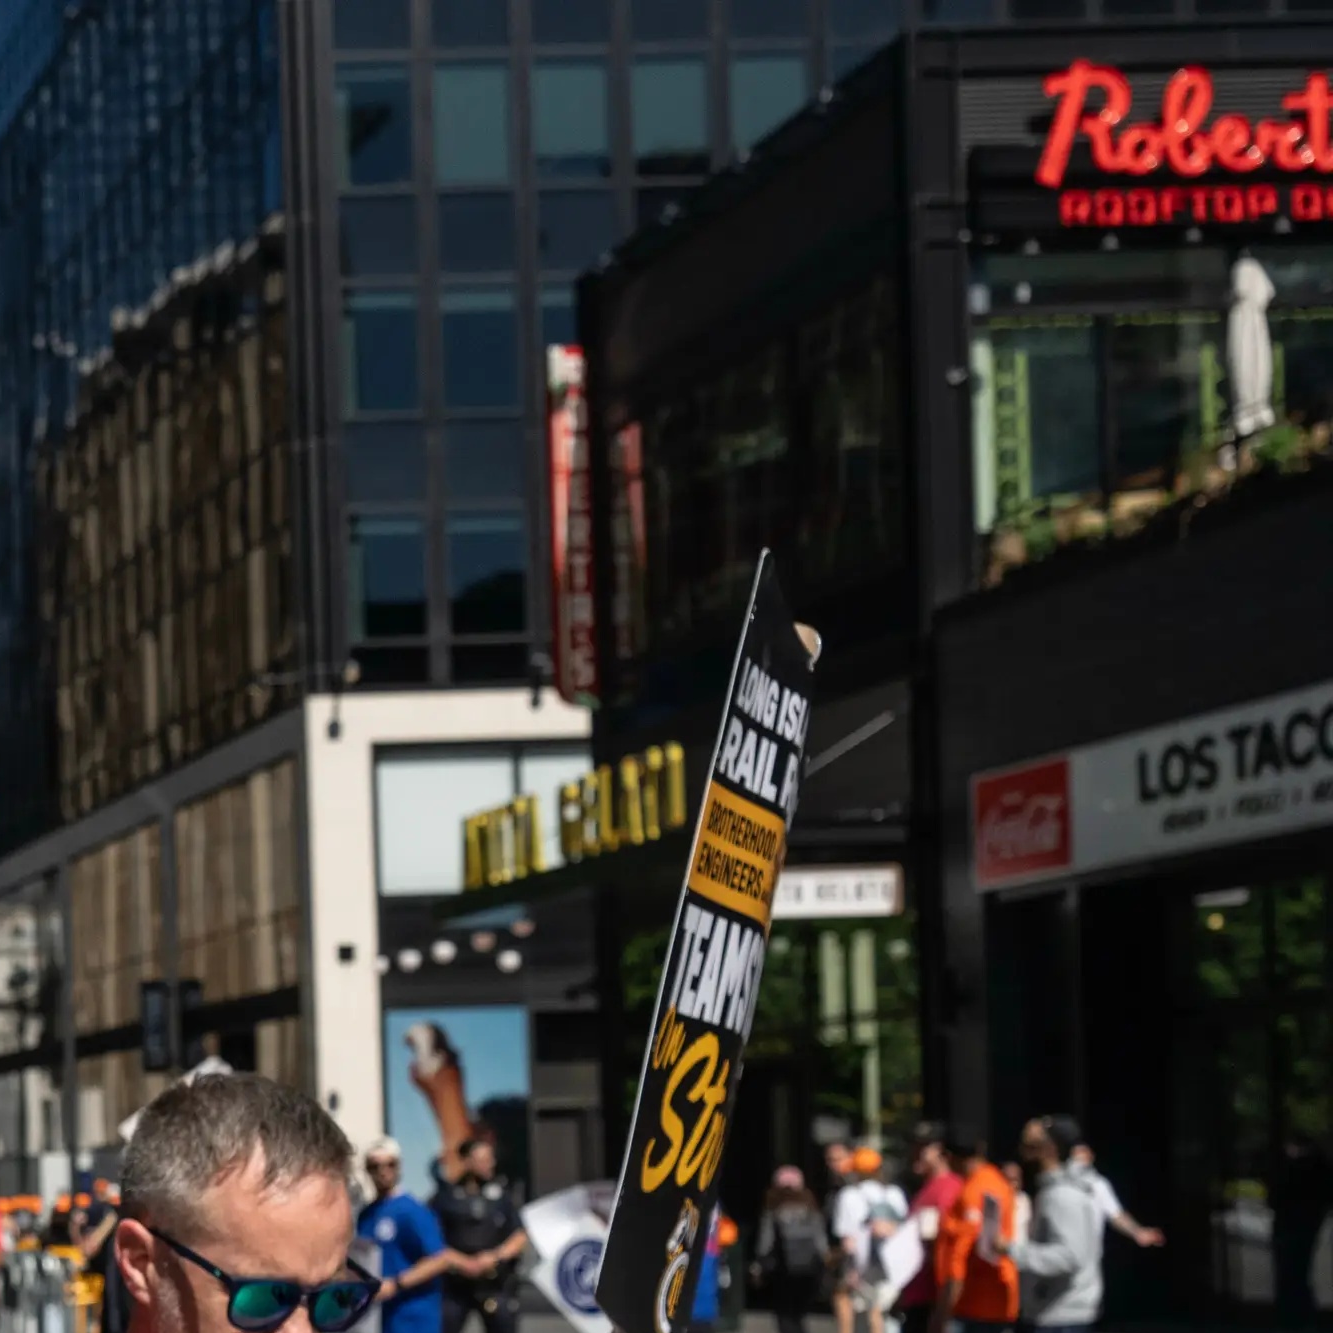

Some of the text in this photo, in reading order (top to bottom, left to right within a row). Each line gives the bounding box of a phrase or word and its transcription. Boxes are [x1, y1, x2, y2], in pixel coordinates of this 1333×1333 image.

[1059, 187, 1278, 226] ROOFTOP
[738, 657, 810, 748] LONG ISL
[719, 715, 779, 805] RAIL
[1138, 730, 1219, 803] LOS
[707, 798, 778, 863] BROTHERHOOD
[697, 843, 764, 899] ENGINEERS
[671, 902, 765, 1044] TEAMS
